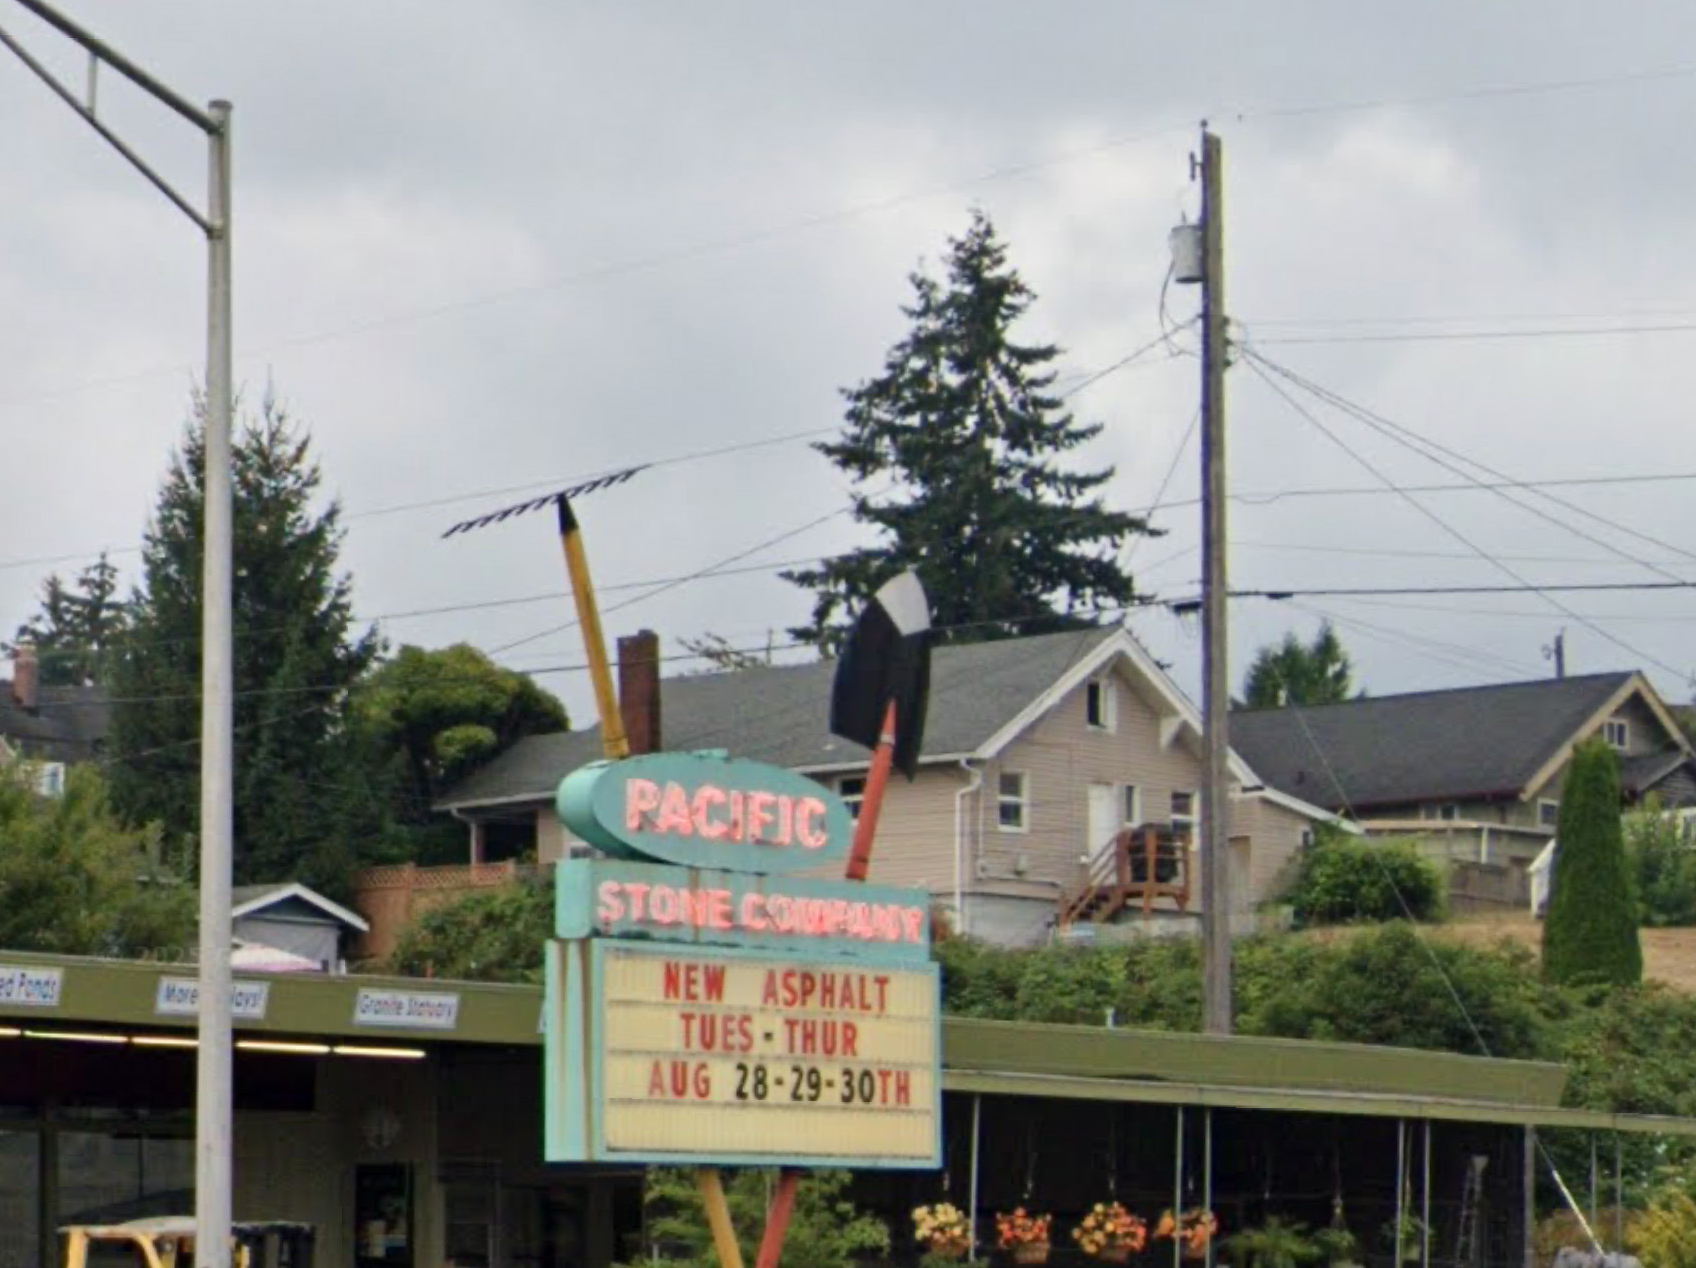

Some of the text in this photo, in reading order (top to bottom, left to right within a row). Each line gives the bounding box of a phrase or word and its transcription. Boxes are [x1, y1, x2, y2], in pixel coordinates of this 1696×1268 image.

[625, 778, 827, 848] PACIFIC
[597, 880, 923, 942] STONE COMPANY
[663, 961, 891, 1012] NEW ASPHALT
[649, 1059, 711, 1099] AUG
